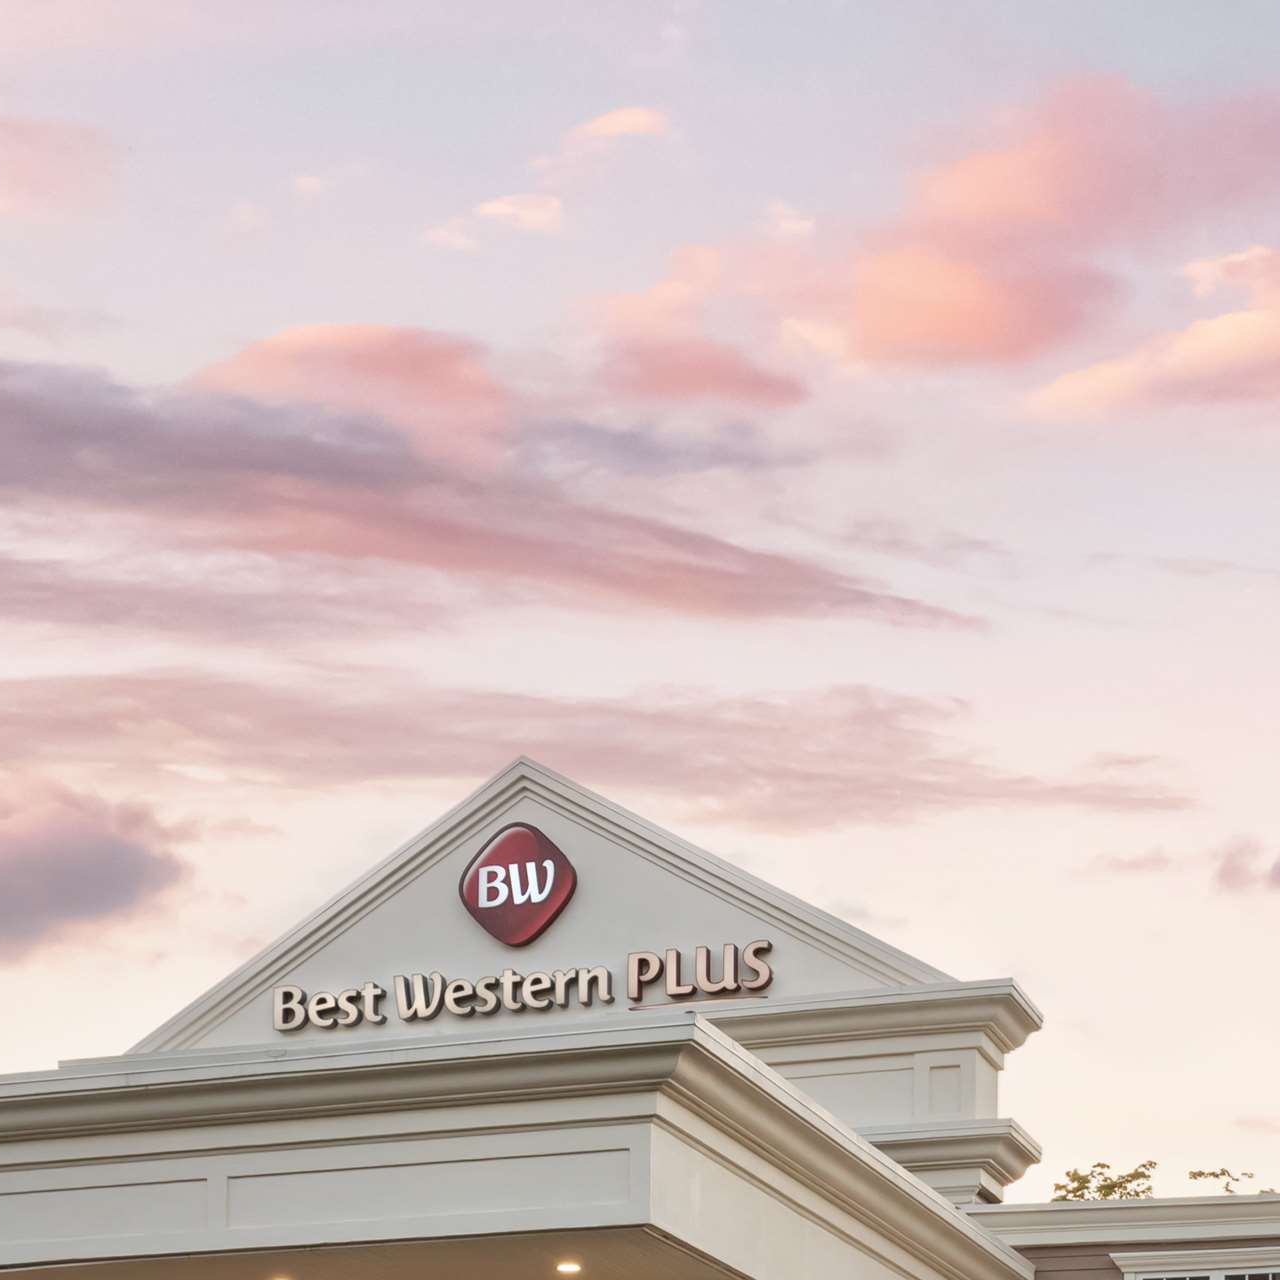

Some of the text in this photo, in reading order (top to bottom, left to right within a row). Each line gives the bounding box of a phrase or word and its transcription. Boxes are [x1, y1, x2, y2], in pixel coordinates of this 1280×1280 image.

[477, 858, 556, 909] BW
[272, 939, 773, 1034] Best Western PLUS
